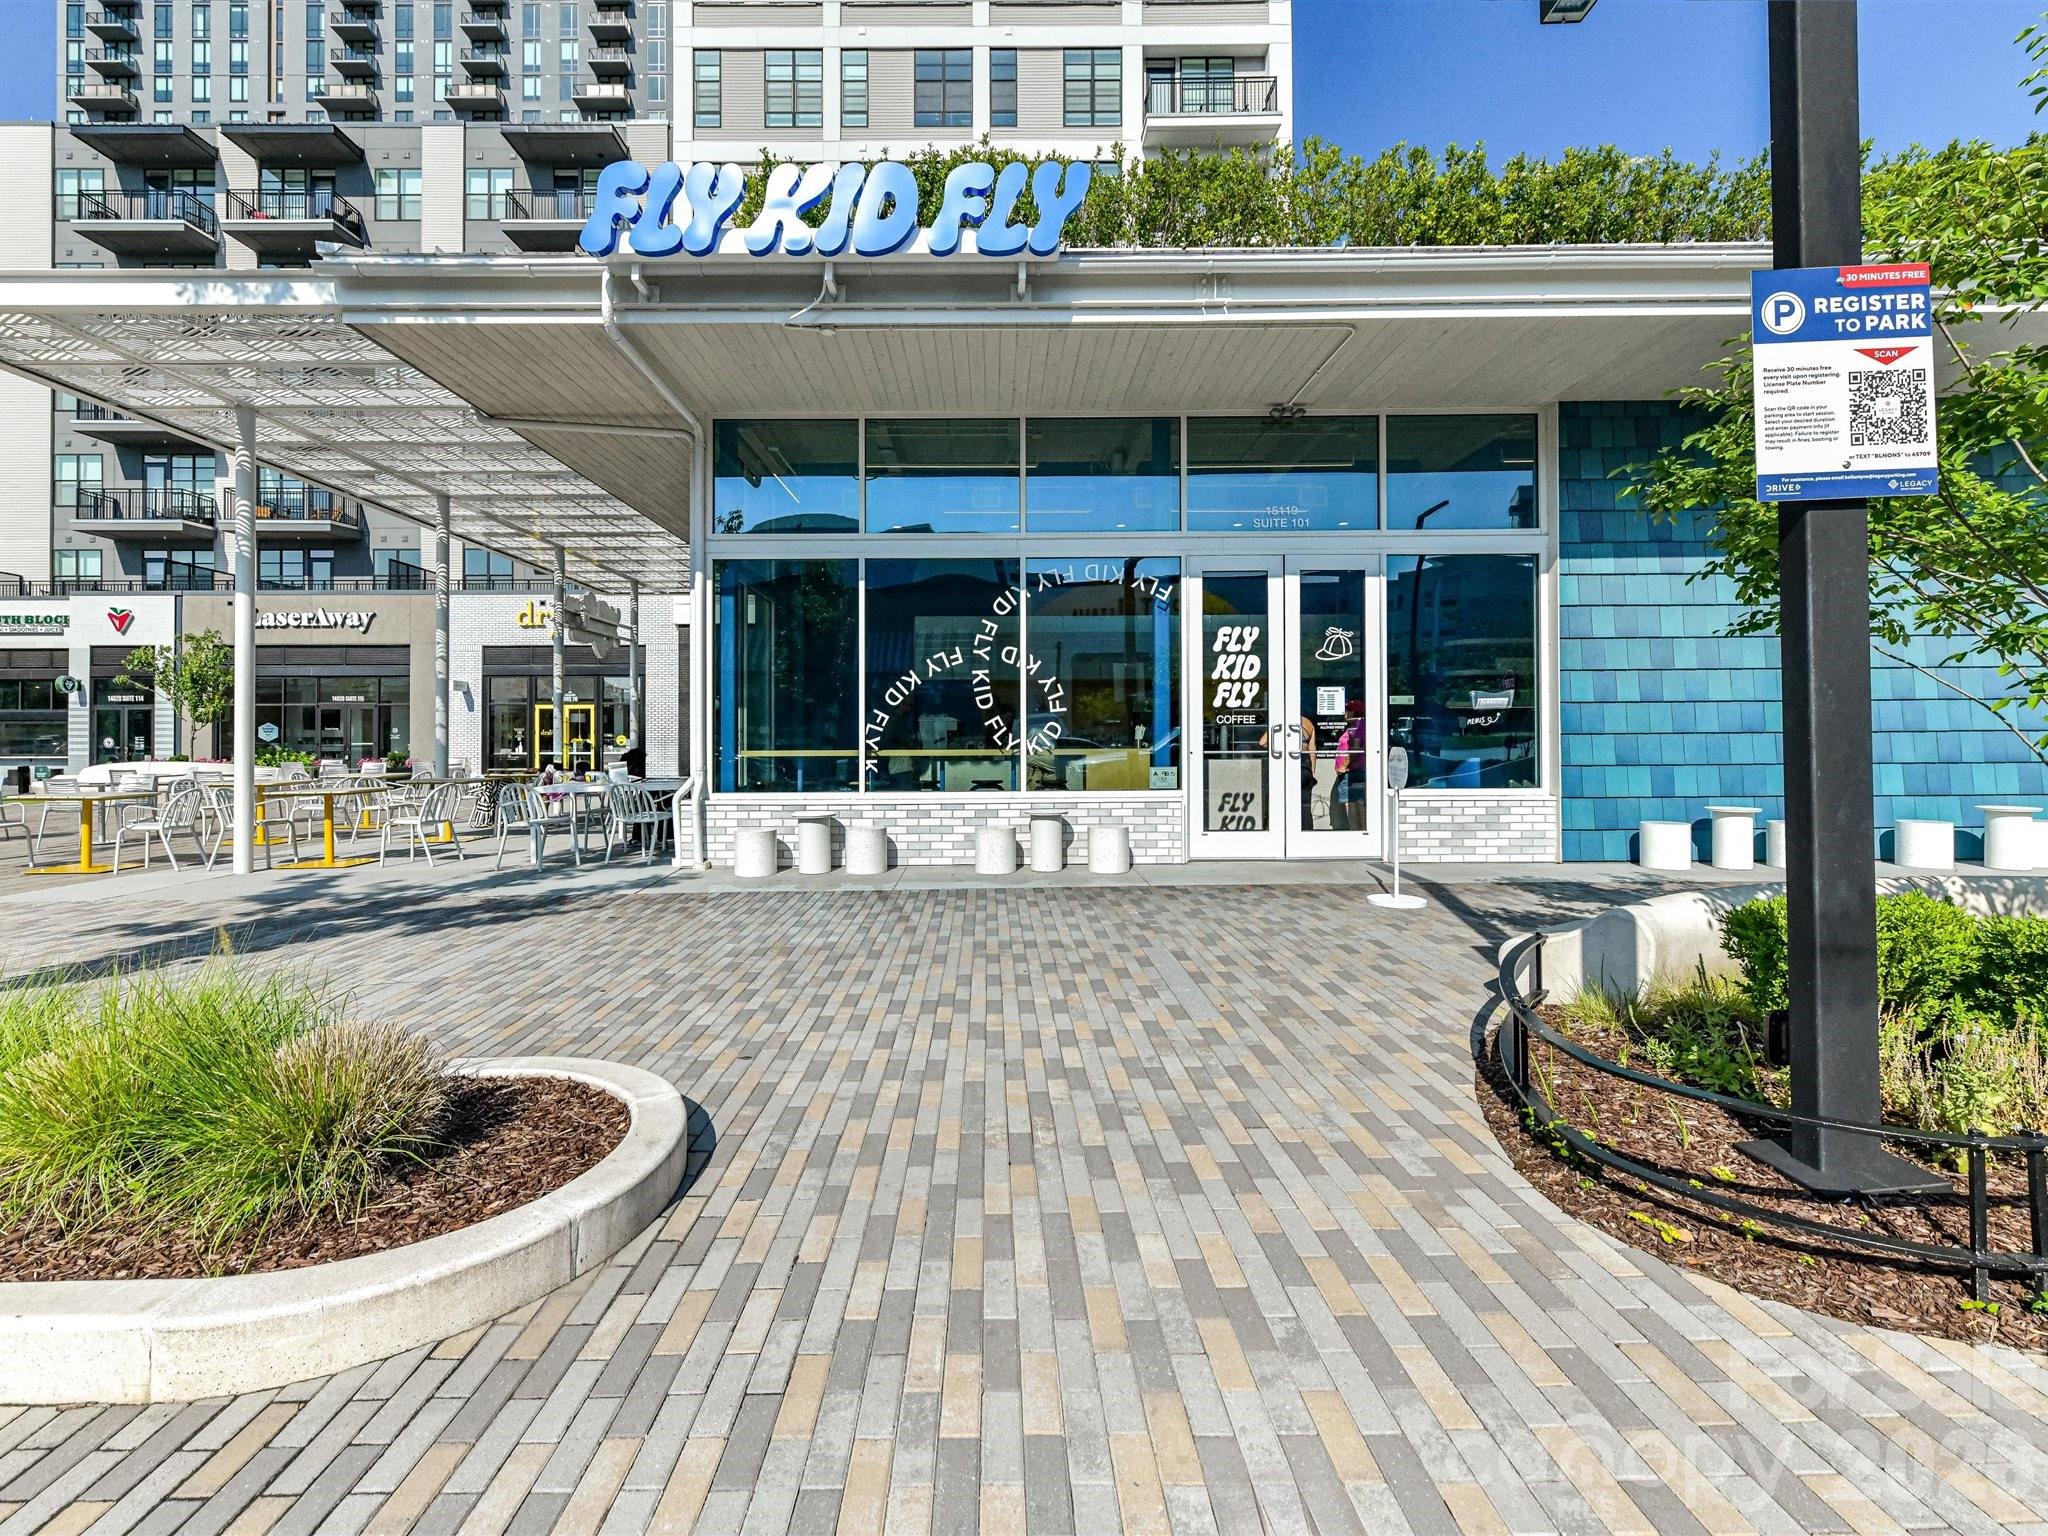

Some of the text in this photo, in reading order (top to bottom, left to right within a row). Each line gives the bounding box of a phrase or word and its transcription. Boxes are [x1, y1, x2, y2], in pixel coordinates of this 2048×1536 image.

[579, 161, 1092, 257] FLY KID FLY
[1859, 272, 1900, 280] MINUTES
[1902, 270, 1926, 279] FREE
[1774, 300, 1796, 327] P
[1814, 293, 1926, 314] REGISTER
[1834, 312, 1926, 333] TO PARK
[1874, 350, 1898, 358] SCAN
[1766, 484, 1794, 492] DRIVE
[1253, 518, 1309, 528] SUITE 101
[1038, 565, 1074, 592] FLY
[1085, 564, 1125, 585] KID
[1130, 573, 1174, 601] FLY
[0, 615, 21, 624] TH
[972, 618, 998, 661] FLY
[1213, 626, 1260, 652] FLY
[926, 646, 964, 678] FLY
[1211, 654, 1261, 680] KID
[884, 670, 922, 706] KID
[972, 670, 994, 710] KID
[1038, 676, 1067, 713] FLY
[1213, 682, 1260, 708] FLY
[1216, 715, 1256, 724] COFFEE
[1467, 716, 1485, 725] MENUS
[984, 715, 1020, 751] FLY
[1027, 721, 1062, 756] KID
[1218, 792, 1254, 812] FLY
